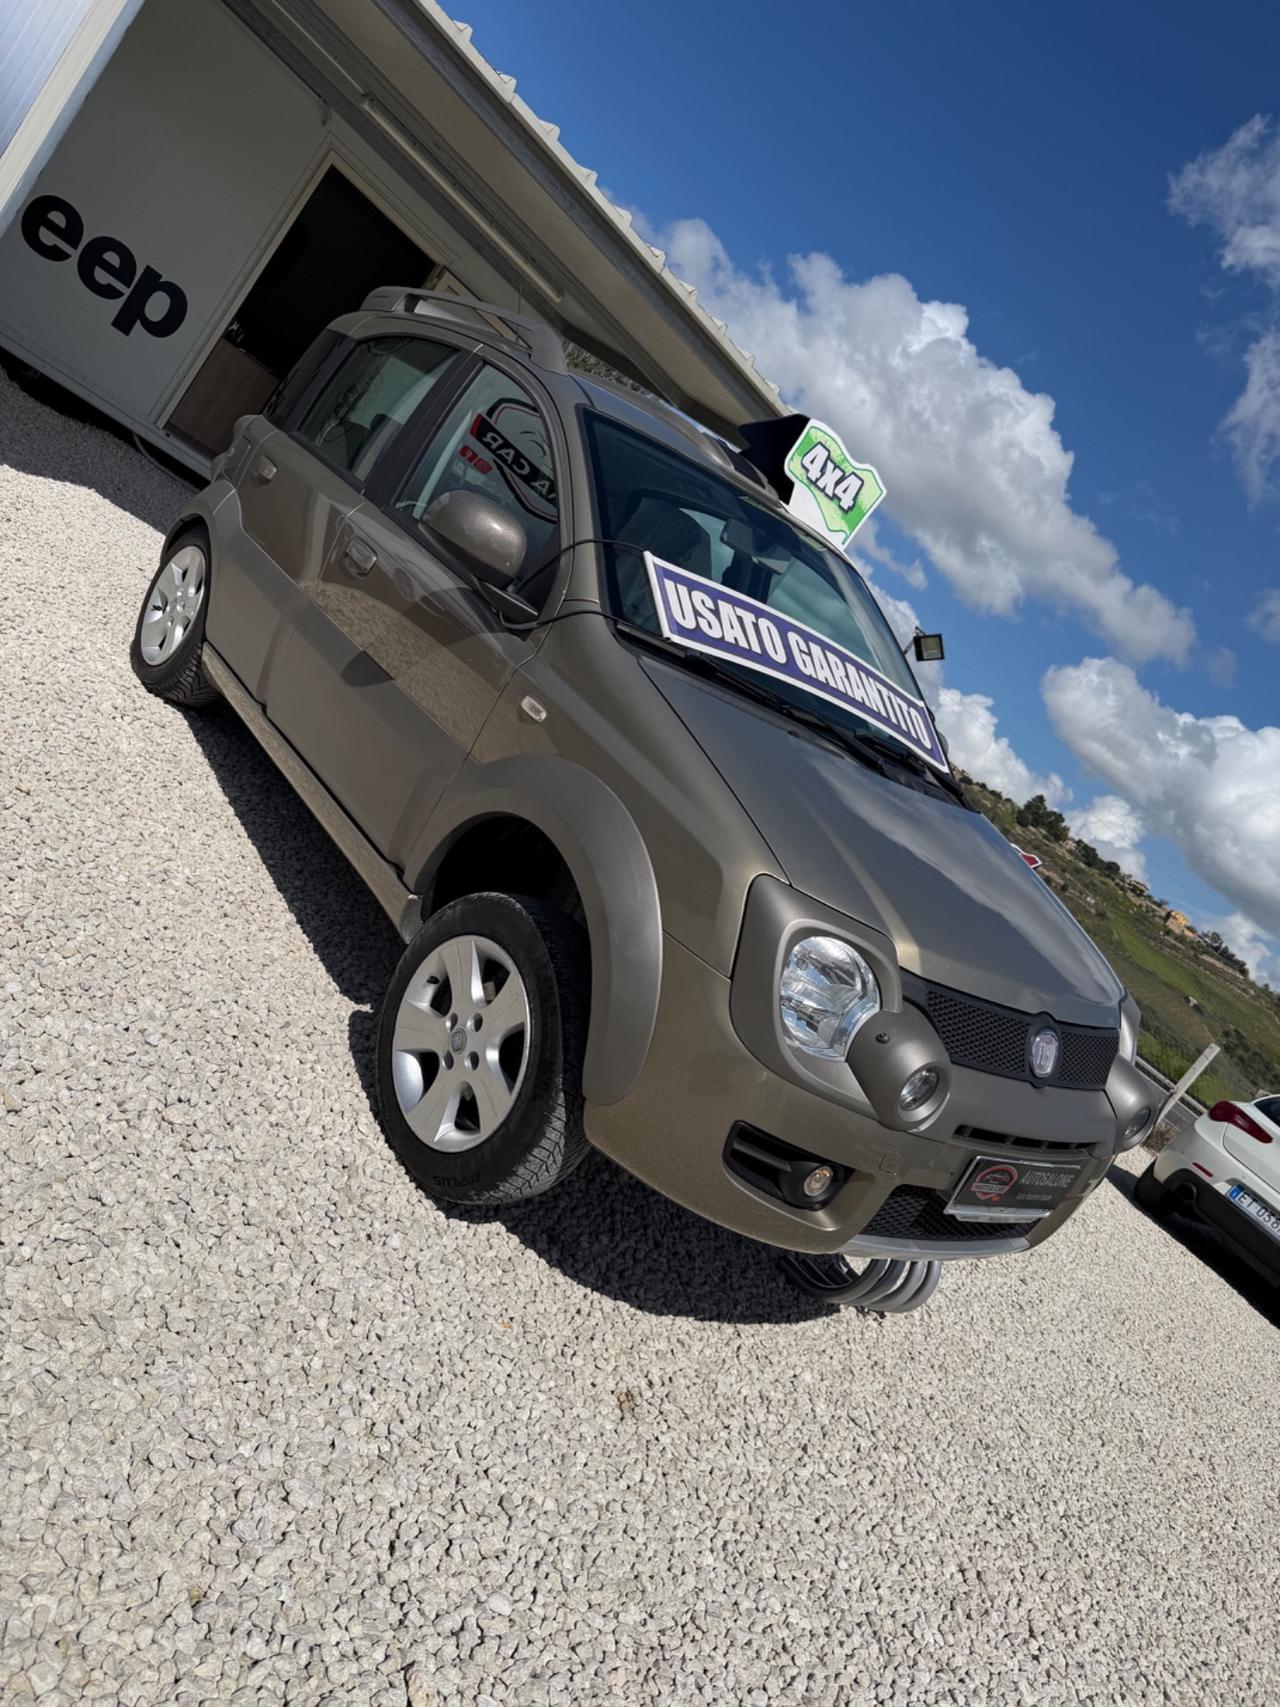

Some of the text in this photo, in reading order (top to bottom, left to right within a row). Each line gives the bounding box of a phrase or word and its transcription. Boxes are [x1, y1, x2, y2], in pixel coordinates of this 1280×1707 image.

[20, 194, 188, 338] eep
[663, 577, 932, 750] USATO GARANTITO
